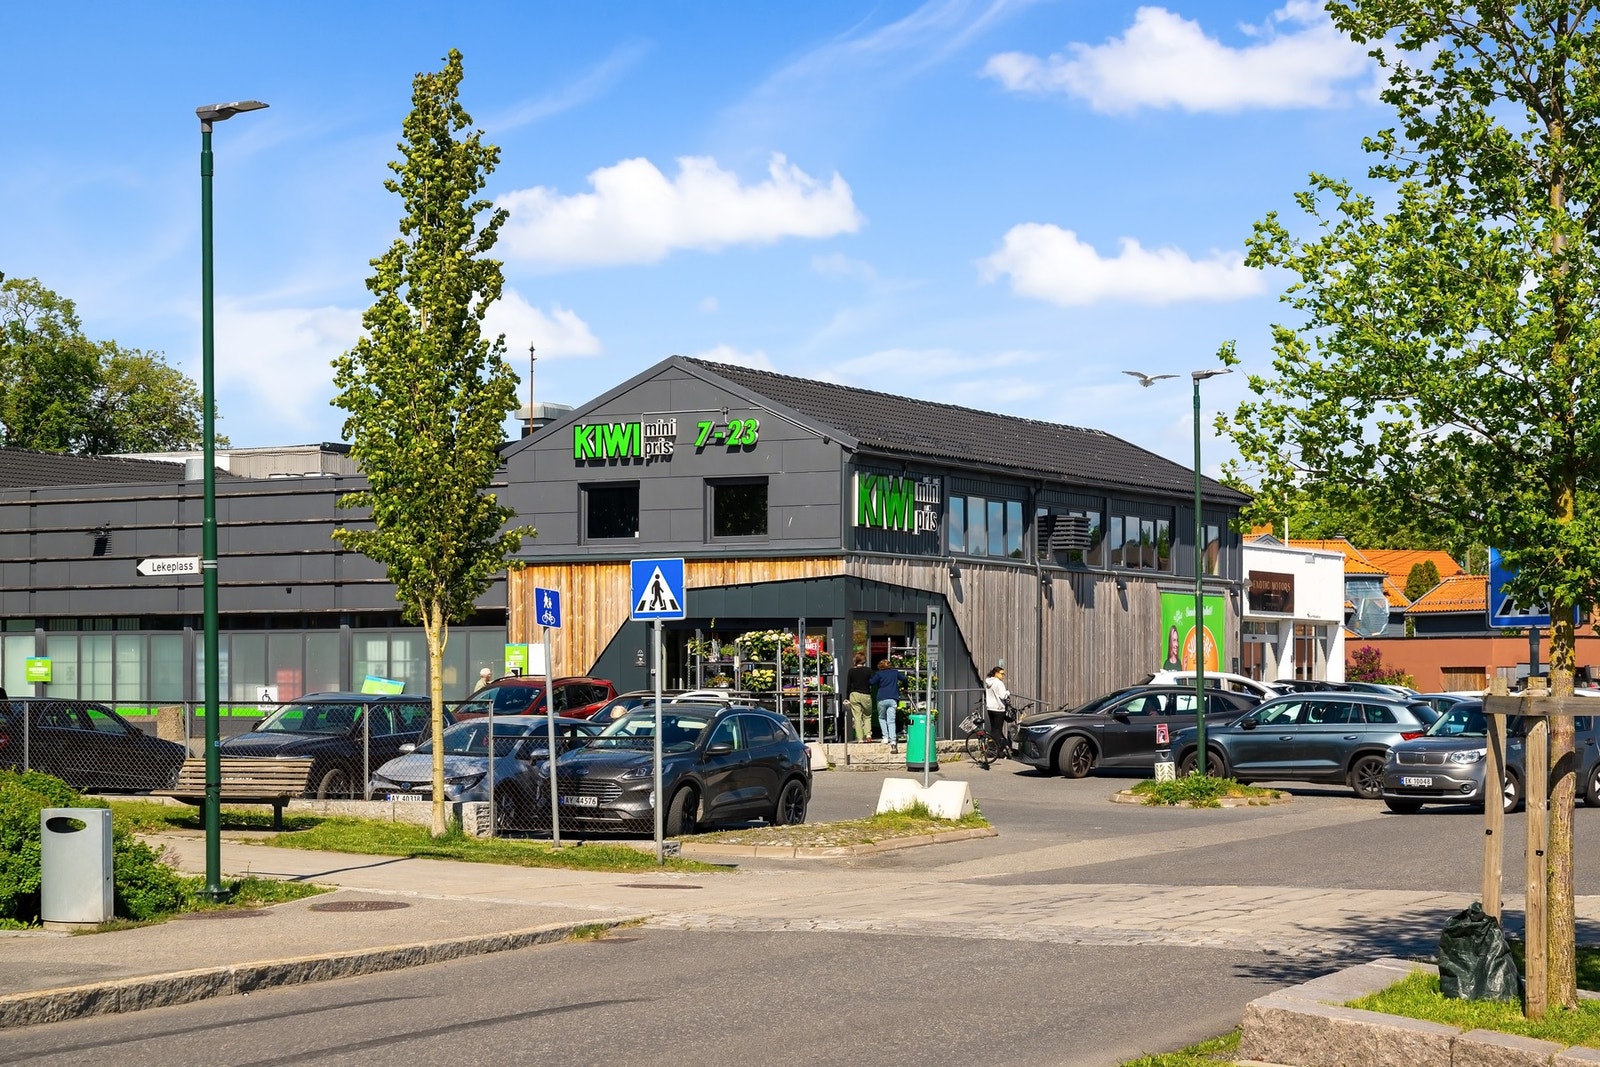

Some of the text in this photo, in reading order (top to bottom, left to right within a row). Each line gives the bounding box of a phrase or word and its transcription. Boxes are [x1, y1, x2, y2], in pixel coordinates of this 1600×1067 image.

[573, 421, 642, 461] KIWI
[644, 418, 677, 437] mini
[644, 438, 674, 460] pris
[857, 472, 915, 532] KIWI
[914, 476, 941, 504] mini
[913, 504, 938, 535] pris
[151, 561, 194, 574] Lekeplass
[930, 611, 938, 641] P
